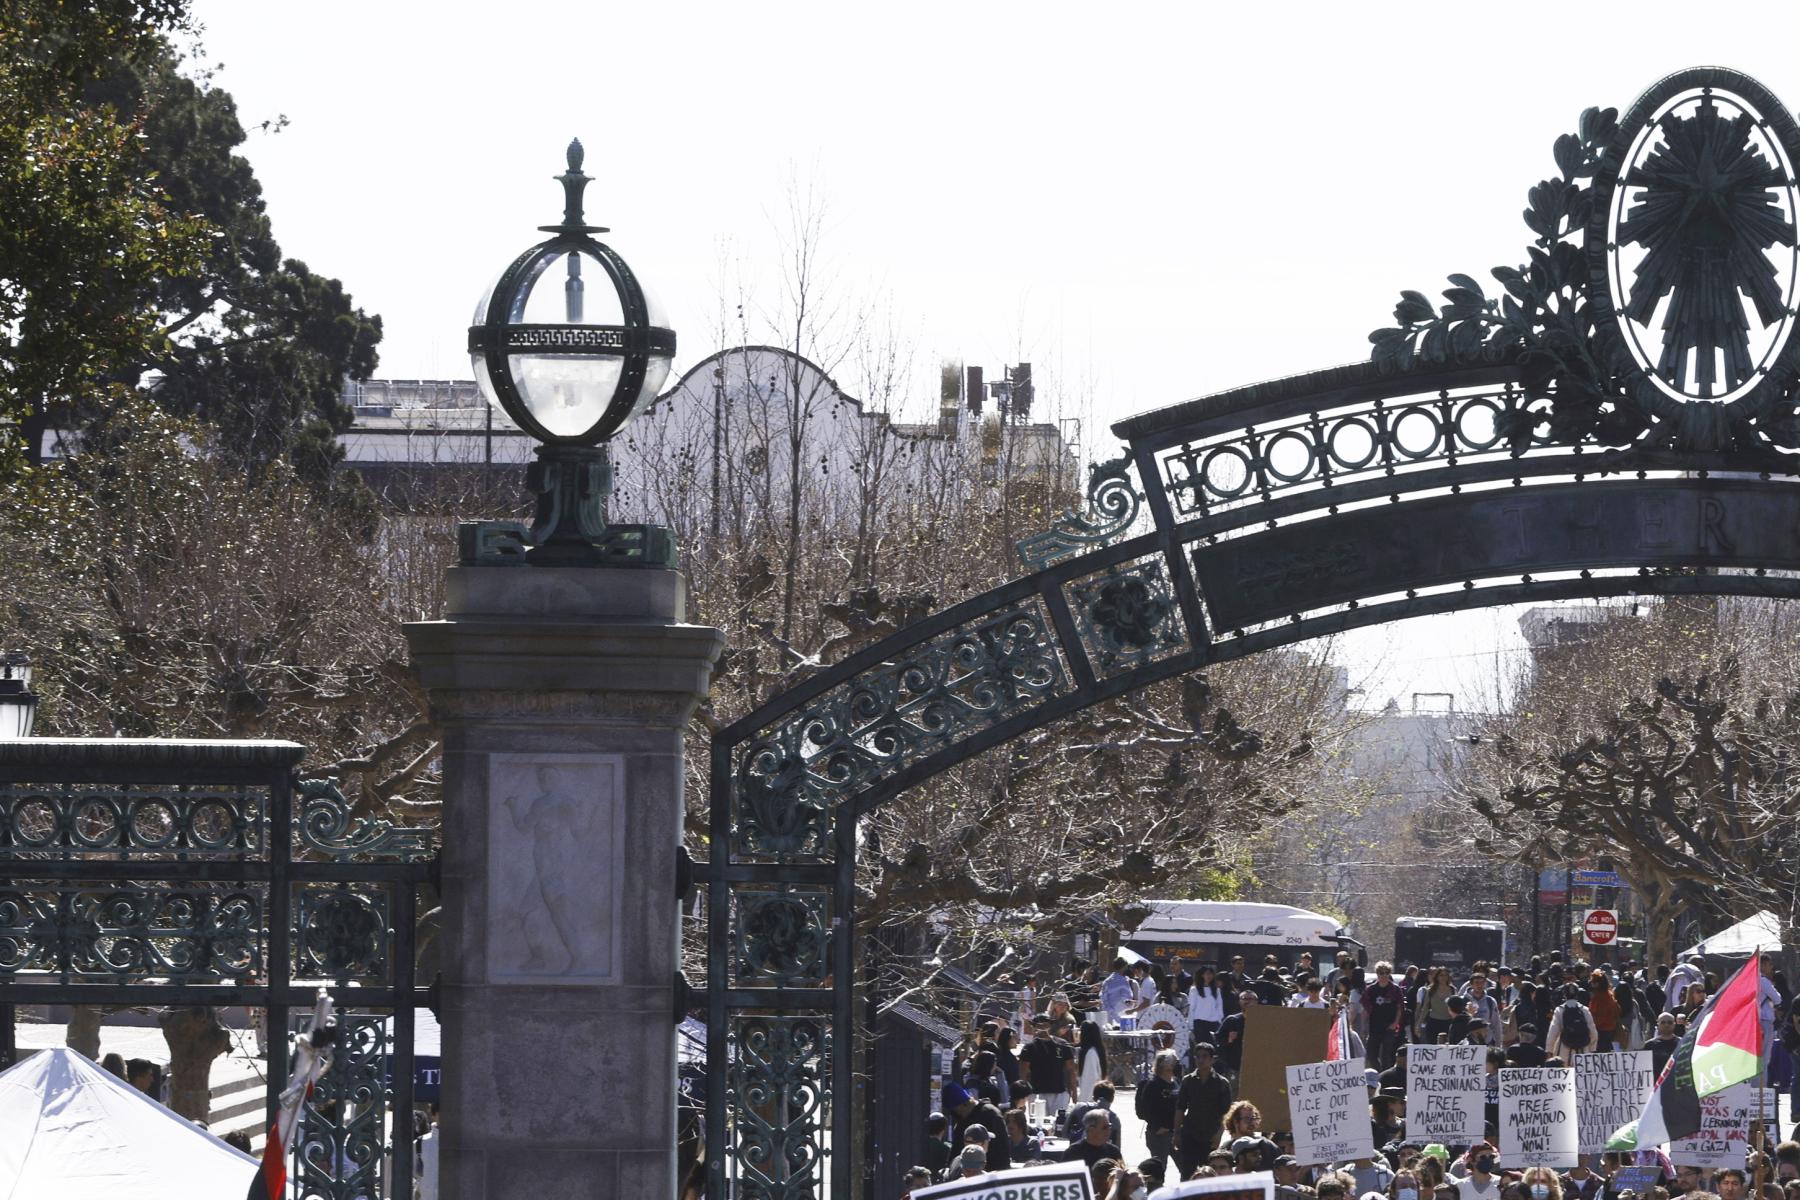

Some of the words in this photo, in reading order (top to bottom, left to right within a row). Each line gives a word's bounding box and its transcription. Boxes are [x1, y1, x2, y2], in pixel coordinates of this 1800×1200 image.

[1574, 873, 1615, 883] Bancroft
[1591, 931, 1610, 939] ENTER
[1413, 1047, 1442, 1062] FIRST
[1449, 1047, 1478, 1060] THEY
[1326, 1061, 1352, 1077] OUT
[1410, 1064, 1437, 1075] CAME
[1442, 1064, 1456, 1075] FOR
[1461, 1064, 1482, 1076] THE
[1575, 1053, 1638, 1074] BERKELEY
[1501, 1070, 1542, 1082] BERKELEY
[1548, 1069, 1570, 1080] CITY
[1575, 1073, 1600, 1091] CITY
[1290, 1086, 1302, 1096] OF
[1309, 1083, 1328, 1093] OUR
[1332, 1076, 1366, 1092] SCHOOLS
[1502, 1083, 1548, 1098] STUDENTS
[1329, 1094, 1350, 1109] OUT
[1427, 1094, 1462, 1111] FREE
[1519, 1099, 1553, 1112] FREE
[1576, 1090, 1603, 1108] SAYS
[1612, 1088, 1647, 1106] FREE
[1307, 1115, 1319, 1126] OF
[1328, 1110, 1348, 1123] THE
[1415, 1111, 1467, 1125] MAHMOUD
[1509, 1110, 1566, 1127] MAHMOUD
[1578, 1105, 1640, 1126] MAHMOUD
[1734, 1108, 1748, 1118] ON
[1426, 1122, 1465, 1134] KHALIL!
[1703, 1118, 1741, 1128] LEBANON
[1311, 1124, 1338, 1140] BAY!
[1517, 1126, 1552, 1141] KHALIL
[1522, 1138, 1550, 1152] NOW!
[1685, 1142, 1697, 1151] ON
[1701, 1141, 1731, 1153] GAZA
